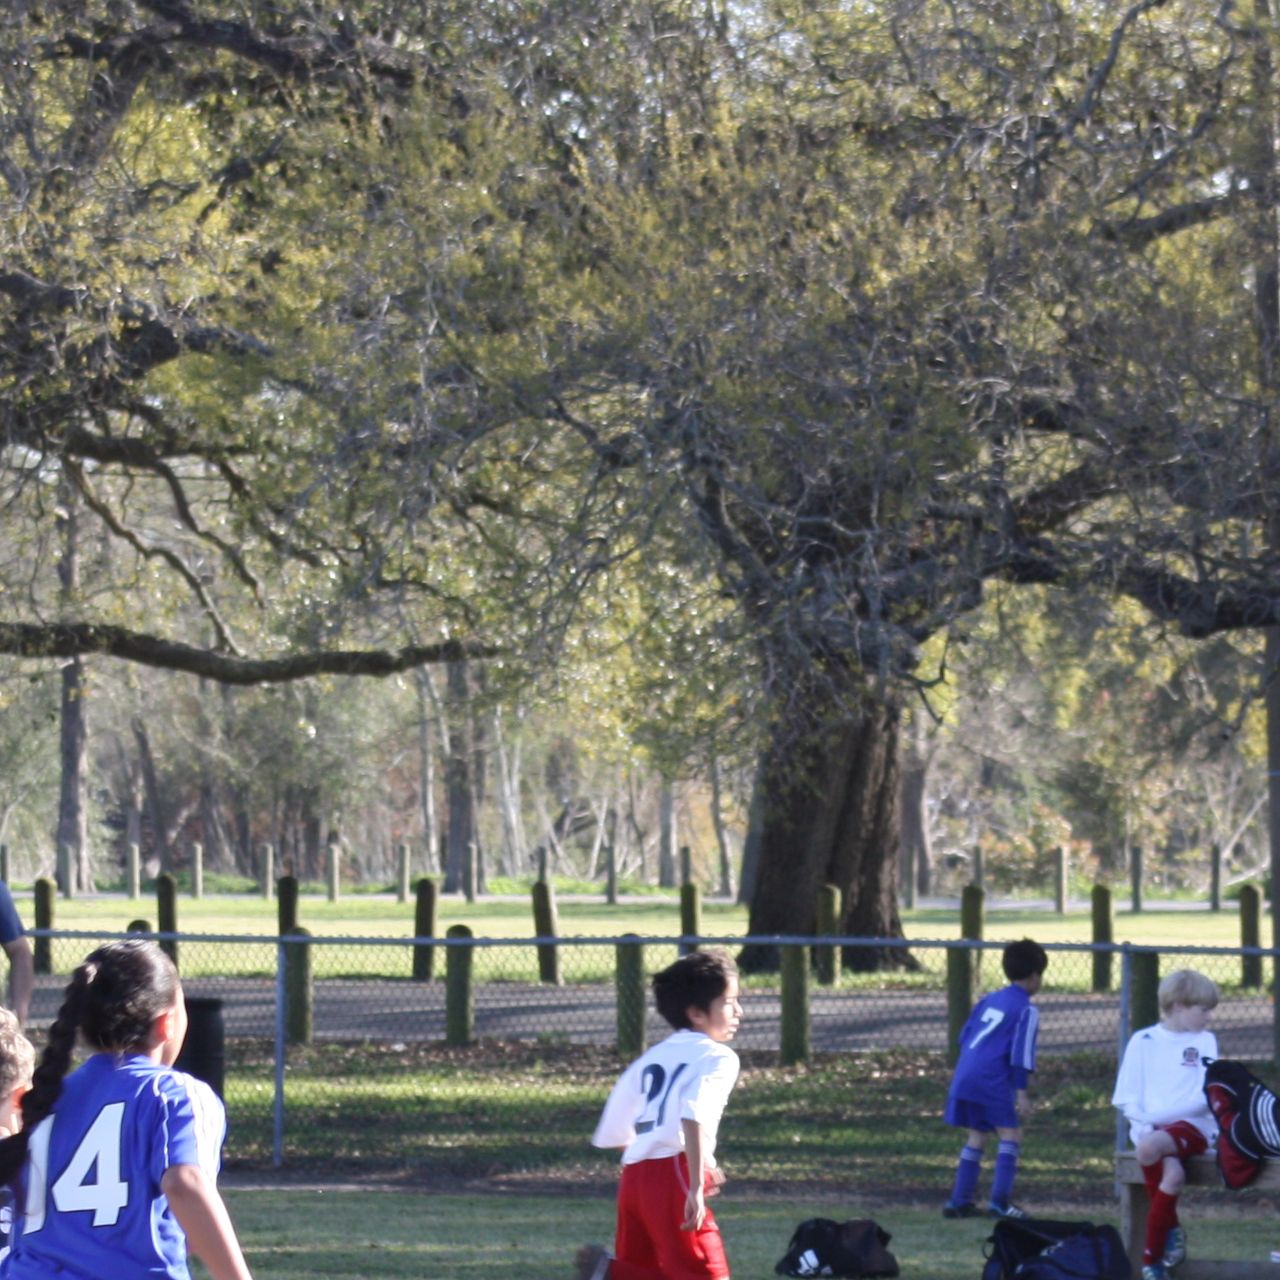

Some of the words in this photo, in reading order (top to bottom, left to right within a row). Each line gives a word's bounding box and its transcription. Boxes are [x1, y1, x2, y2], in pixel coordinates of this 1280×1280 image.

[969, 1007, 1005, 1049] 7
[634, 1062, 688, 1136] 21
[22, 1101, 128, 1235] 14
